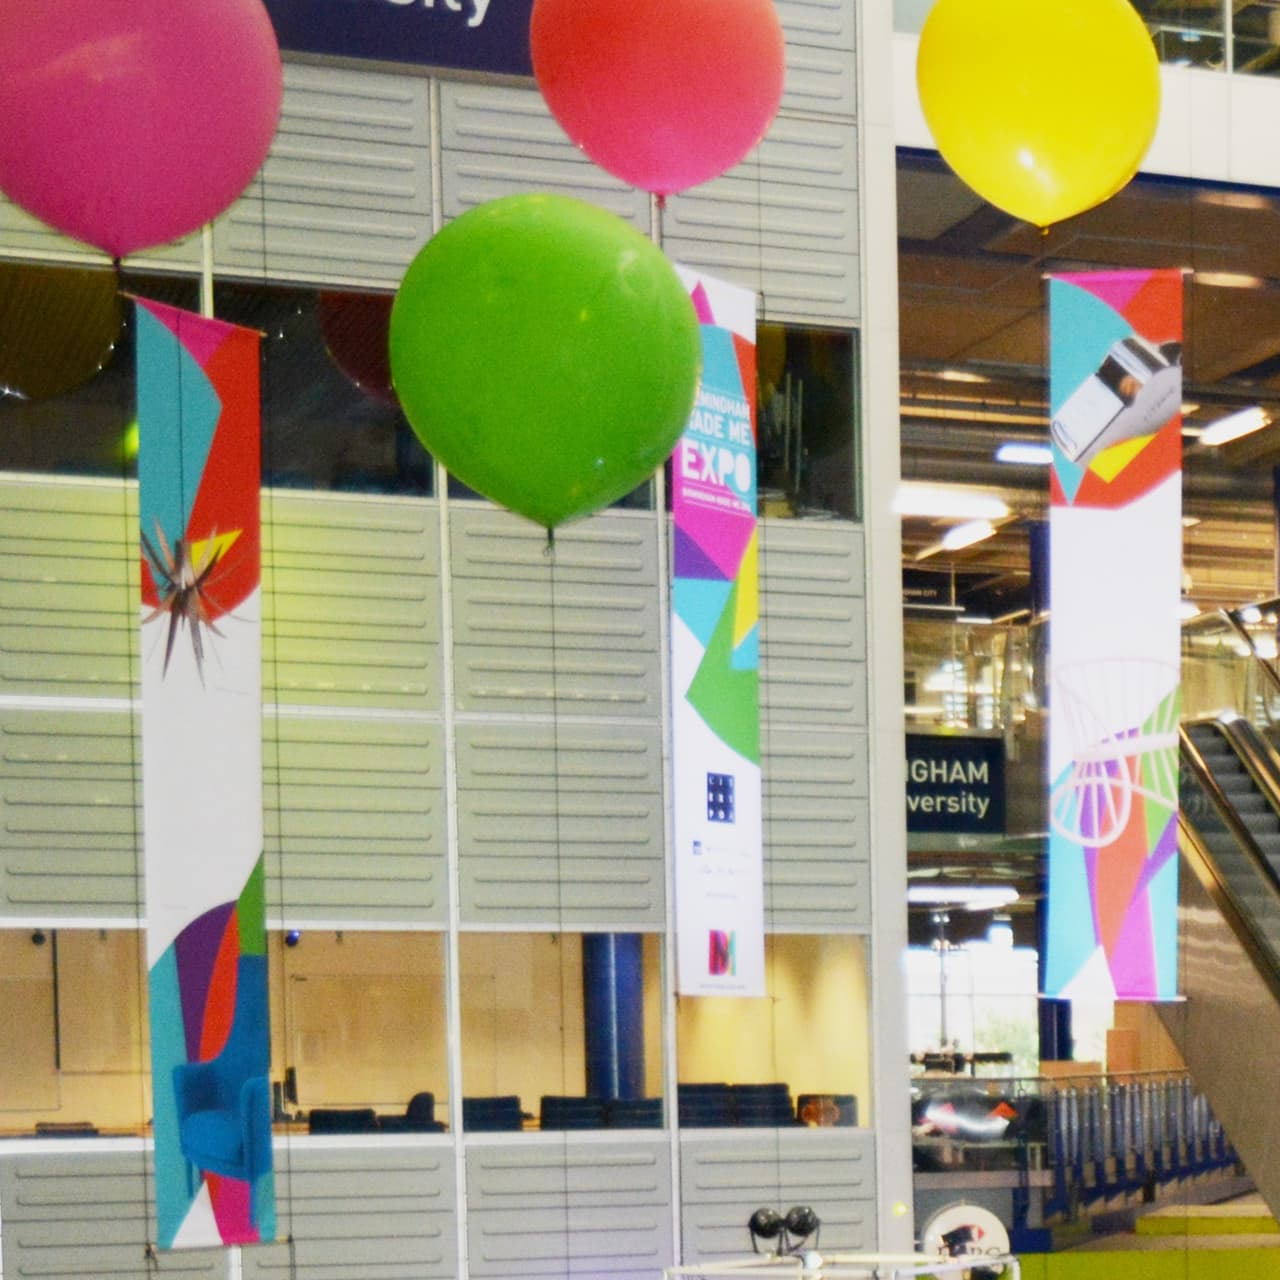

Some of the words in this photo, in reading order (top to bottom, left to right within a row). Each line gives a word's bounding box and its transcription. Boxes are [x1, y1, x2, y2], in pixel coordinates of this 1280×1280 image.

[696, 391, 750, 419] MINGHAM
[729, 420, 750, 445] ME
[682, 438, 751, 492] EXPO
[907, 791, 990, 819] versity
